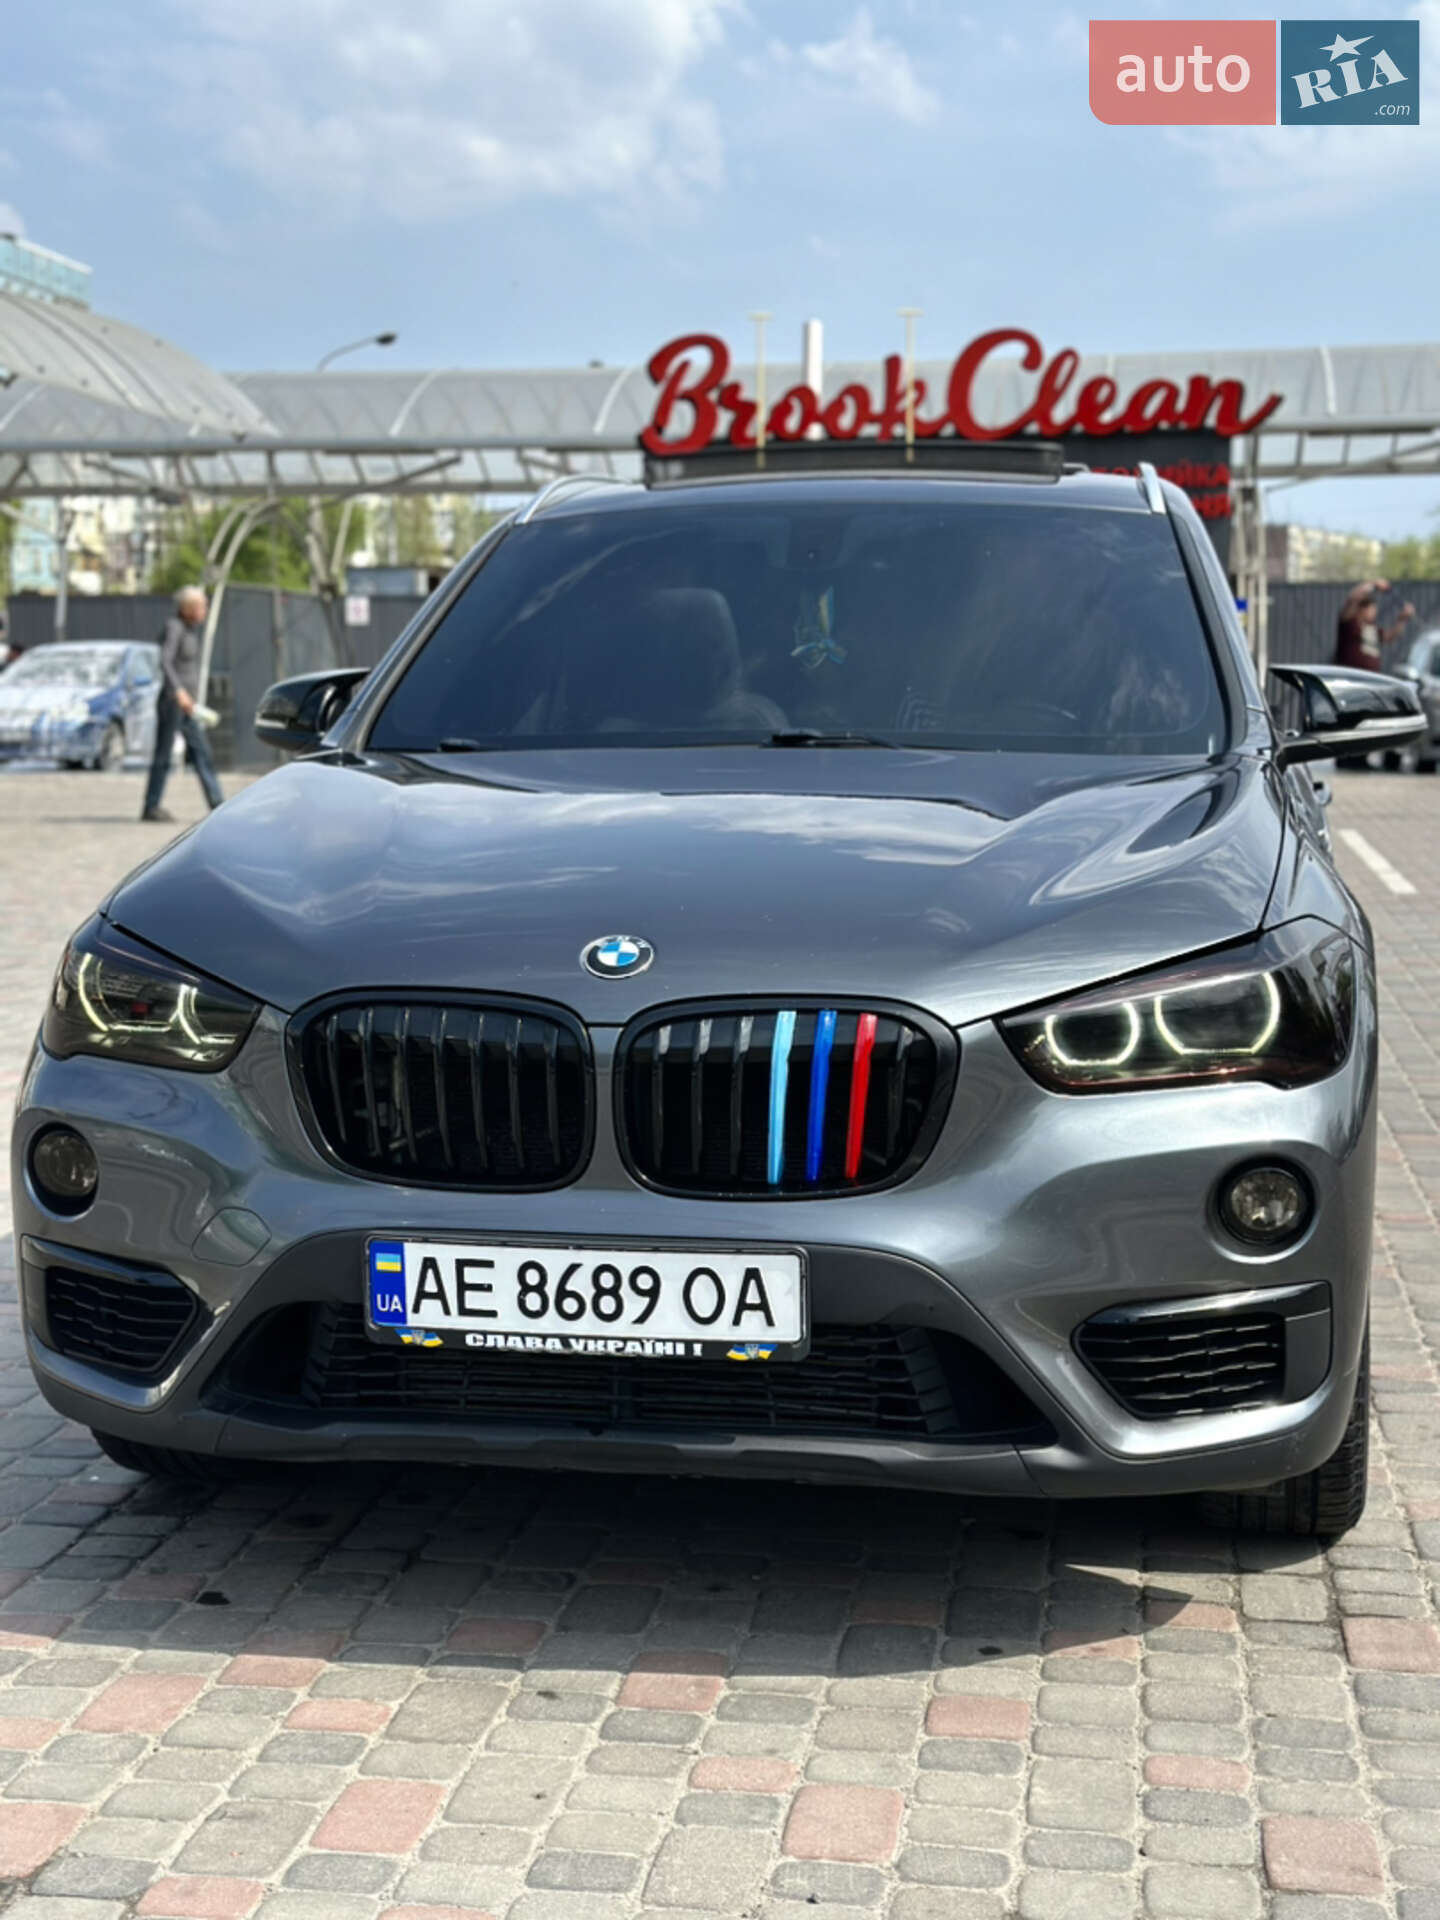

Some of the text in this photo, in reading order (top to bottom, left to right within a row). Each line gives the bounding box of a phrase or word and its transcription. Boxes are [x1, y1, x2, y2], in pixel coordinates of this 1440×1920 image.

[411, 1256, 776, 1328] AE 8689 OA
[376, 1294, 404, 1314] UA
[465, 1333, 564, 1350] СЛАВА
